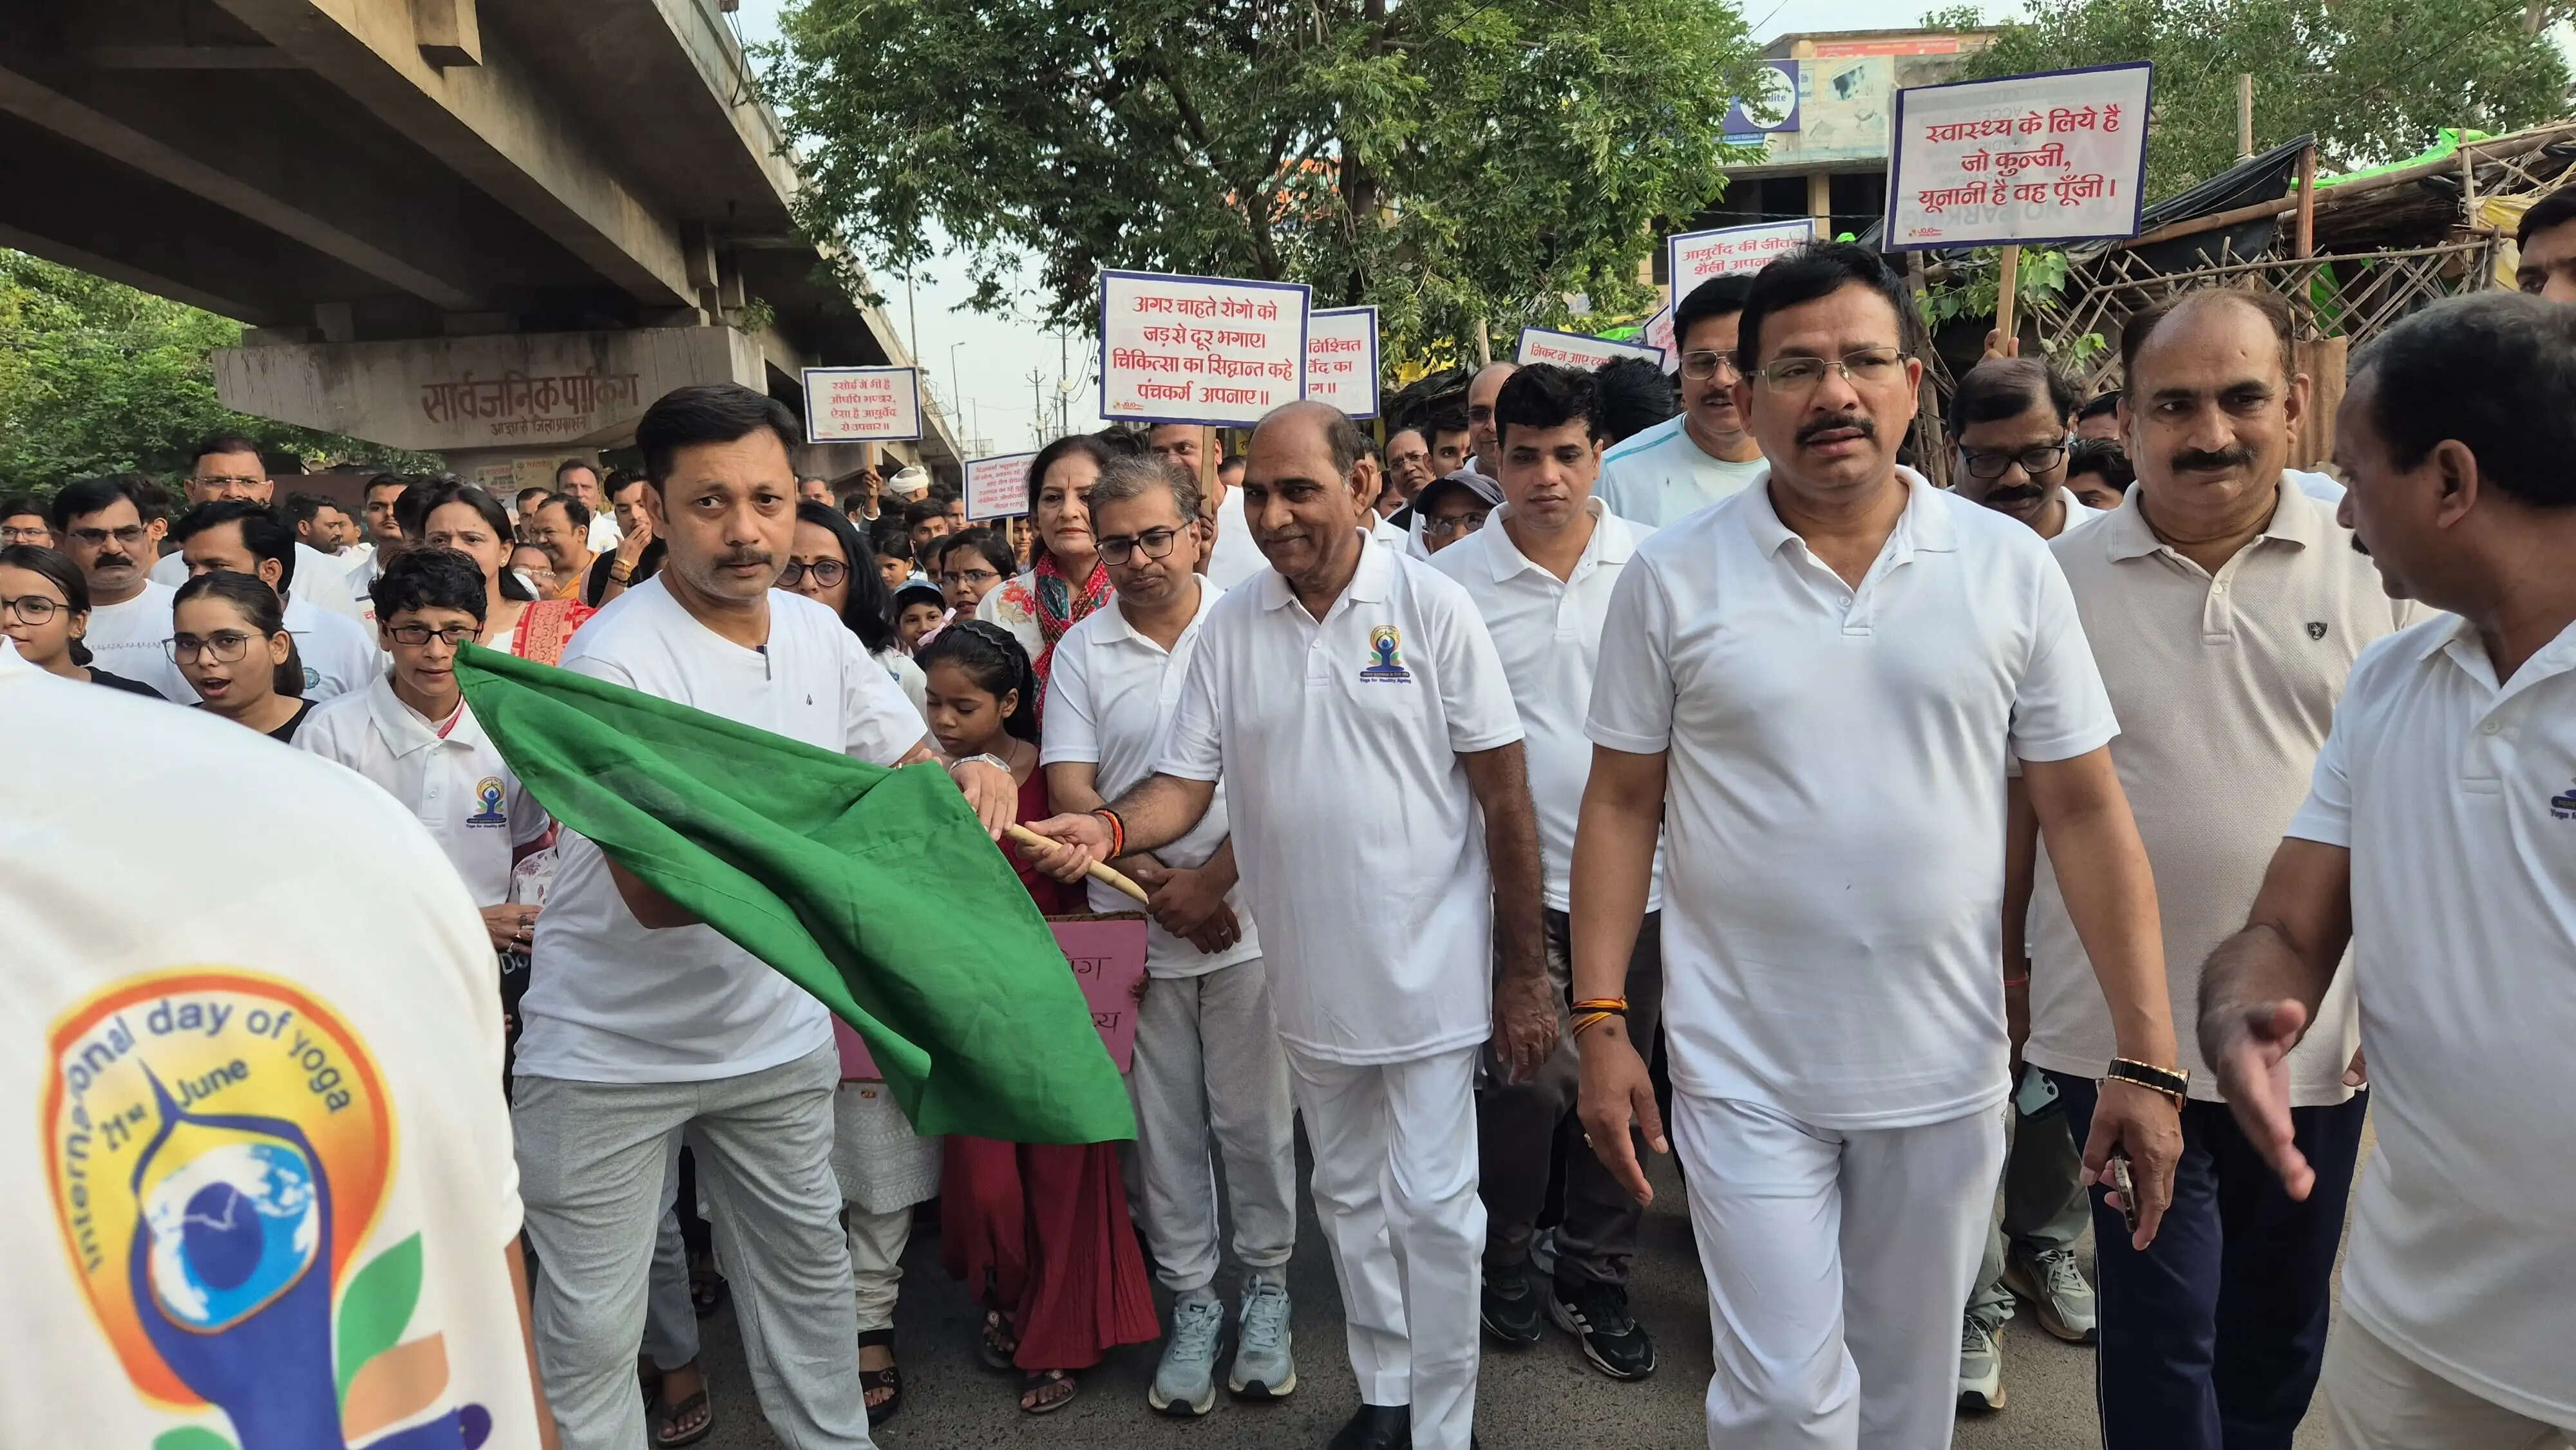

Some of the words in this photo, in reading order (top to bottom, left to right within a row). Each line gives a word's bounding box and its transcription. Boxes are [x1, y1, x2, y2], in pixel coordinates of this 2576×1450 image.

[1926, 118, 2013, 144] स्वास्थ्य
[2019, 110, 2044, 135] के
[2049, 108, 2098, 133] लिये
[2103, 103, 2121, 133] है
[1962, 148, 1990, 171] जो
[1995, 142, 2071, 177] कुन्जी,
[1918, 180, 1987, 214] यूनानी
[1992, 178, 2008, 205] है
[2014, 183, 2049, 203] वह
[1681, 242, 1735, 263] आयुर्वेद
[1738, 240, 1758, 252] की
[1694, 259, 1725, 276] शैली
[1133, 297, 1173, 313] अगर
[1177, 296, 1217, 318] चाहते
[1220, 297, 1254, 319] रोगो
[1257, 300, 1278, 321] को
[1190, 329, 1214, 352] दूर
[1218, 330, 1265, 348] भगाए।
[1530, 342, 1558, 359] निकट
[1113, 346, 1180, 372] चिकित्सा
[1183, 358, 1204, 373] का
[1268, 358, 1293, 381] कहे
[1309, 358, 1330, 375] र्वेद
[1333, 361, 1352, 372] का
[422, 370, 559, 423] सार्वजनिक
[1137, 378, 1194, 401] पंचकर्म
[147, 998, 233, 1038] day
[247, 1010, 292, 1039] of
[289, 1029, 351, 1114] yoga
[177, 1059, 249, 1108] June
